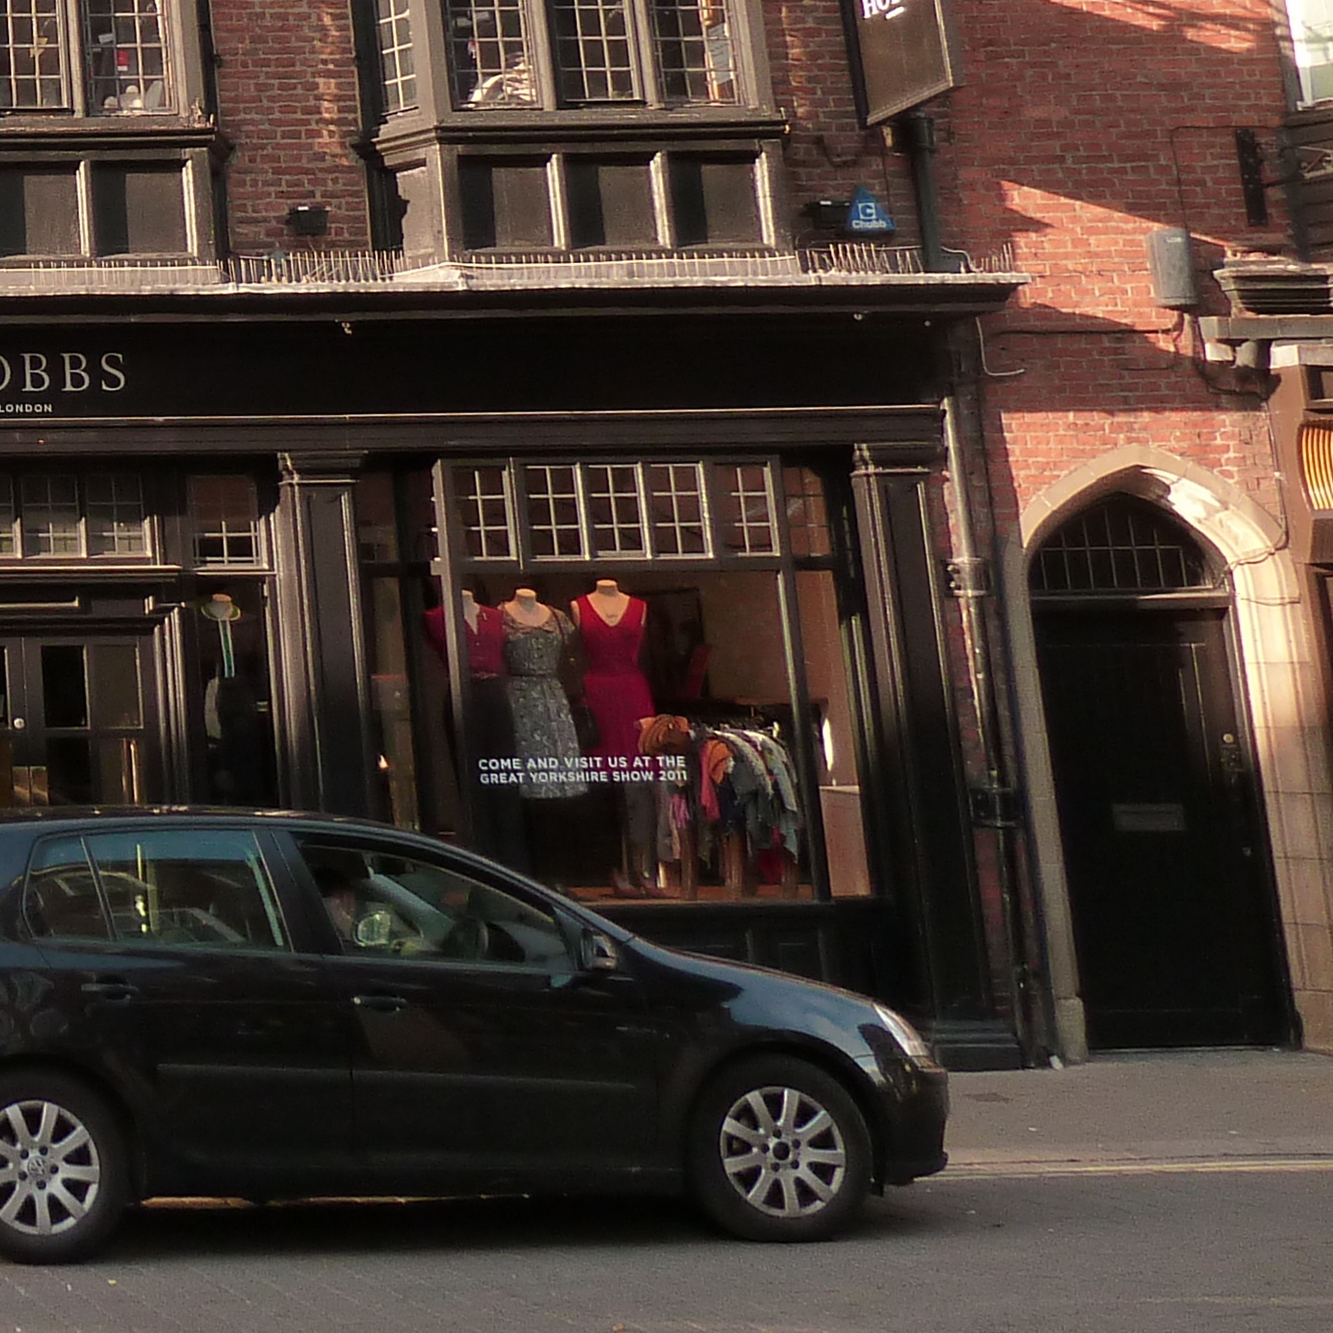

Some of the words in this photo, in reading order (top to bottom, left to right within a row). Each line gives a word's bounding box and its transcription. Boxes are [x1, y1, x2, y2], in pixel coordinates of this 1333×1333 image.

[478, 758, 521, 770] COME
[526, 757, 559, 770] AND
[564, 756, 603, 769] VISIT
[608, 756, 627, 768] US
[632, 756, 652, 768] AT
[656, 755, 686, 767] THE
[479, 772, 525, 784] GREAT
[530, 771, 608, 783] YORKSHIRE
[612, 770, 654, 782] SHOW
[658, 770, 688, 782] 2011
